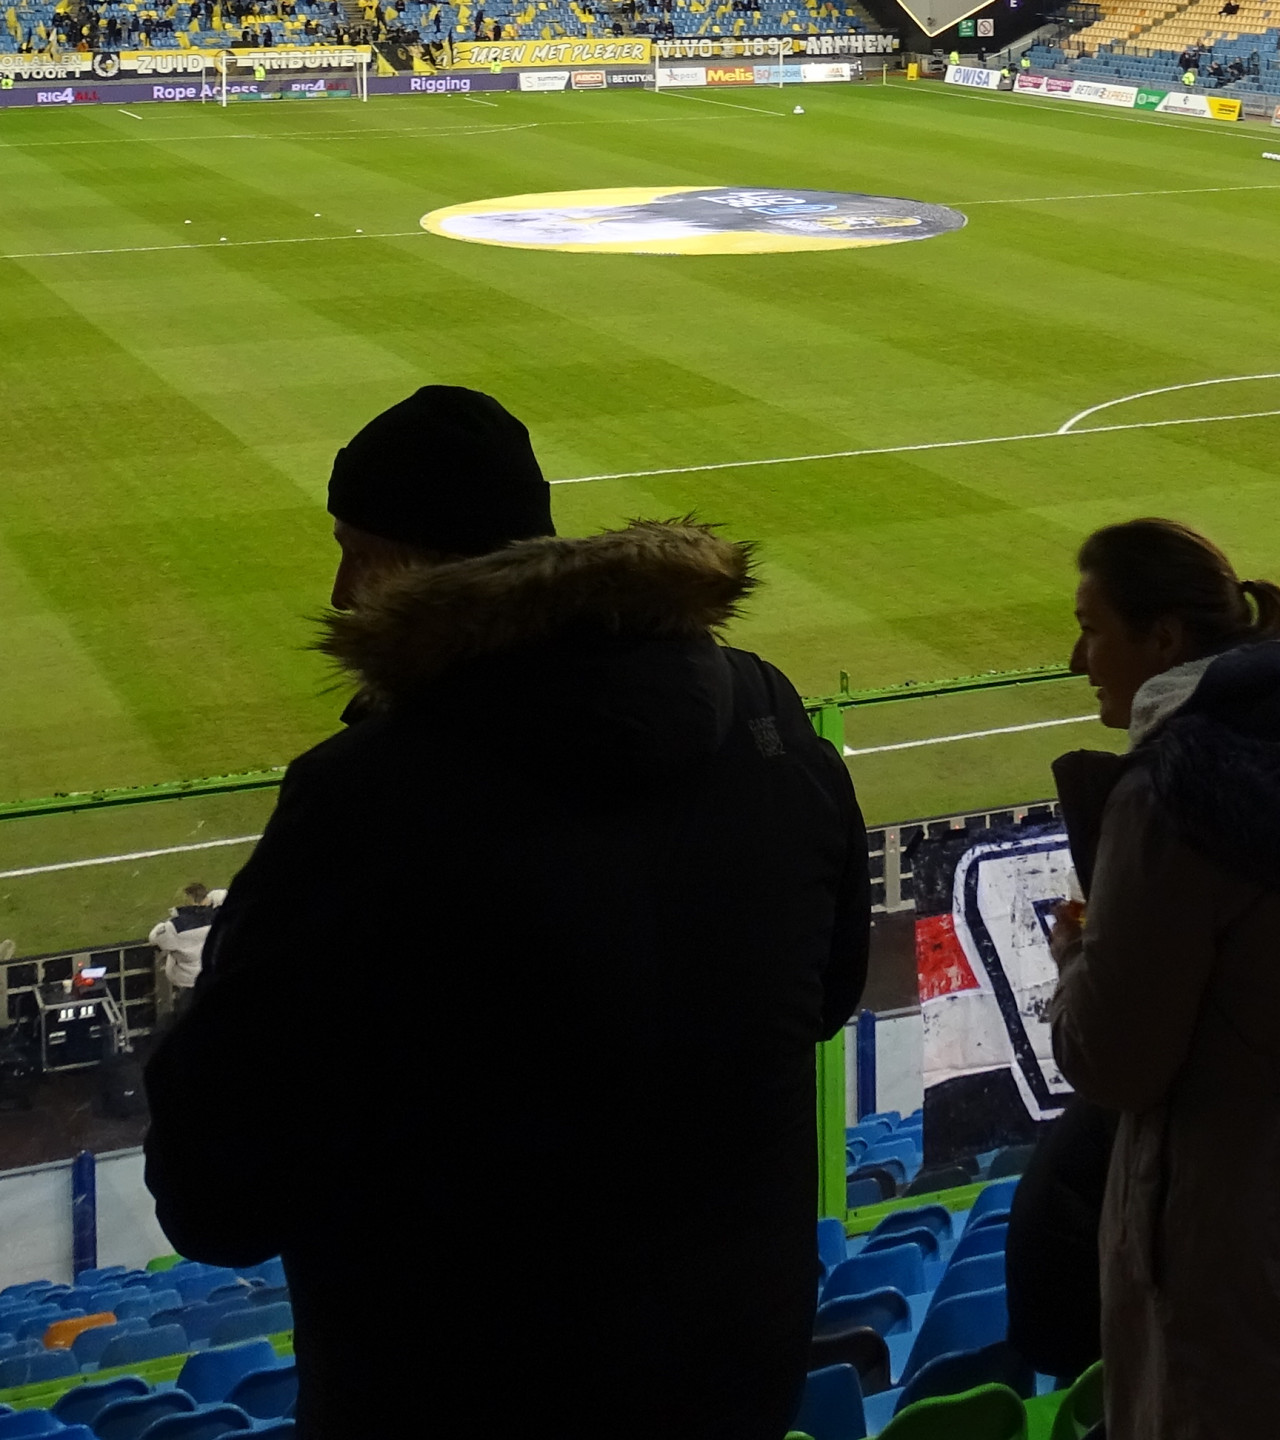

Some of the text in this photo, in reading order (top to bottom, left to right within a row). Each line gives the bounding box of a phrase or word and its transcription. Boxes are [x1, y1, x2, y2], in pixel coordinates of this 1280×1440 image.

[532, 44, 571, 61] MET
[571, 43, 645, 60] PLEZIER
[657, 35, 894, 58] VIVO 1892 ARNHEM
[136, 50, 355, 74] ZUID TRIBUNE
[20, 67, 67, 79] VOOR
[707, 67, 754, 82] Melis
[960, 68, 991, 87] WISA
[153, 85, 196, 101] Rope
[411, 76, 471, 93] Rigging
